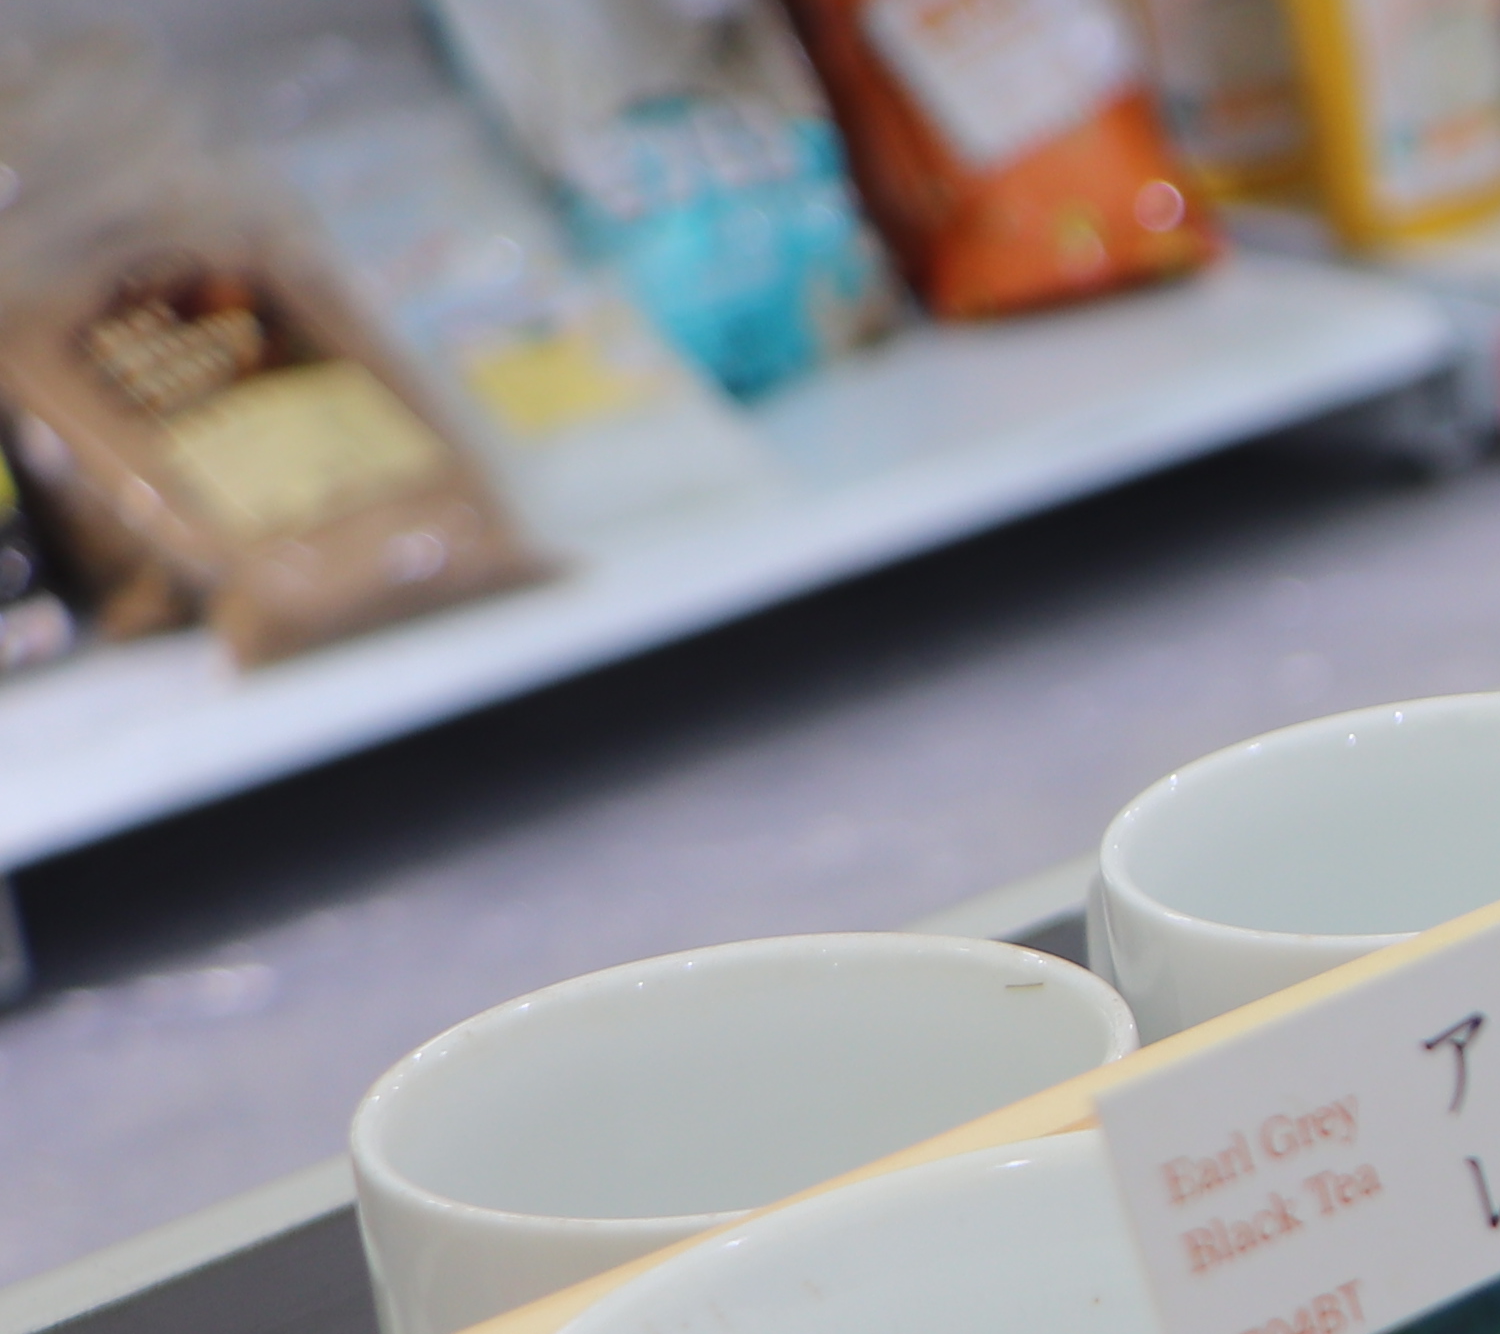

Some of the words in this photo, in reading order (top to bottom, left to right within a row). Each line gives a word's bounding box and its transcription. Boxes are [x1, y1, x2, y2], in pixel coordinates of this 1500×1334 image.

[1160, 1130, 1256, 1207] Earl
[1258, 1092, 1360, 1161] Grey
[1180, 1190, 1304, 1274] Black
[1302, 1162, 1384, 1216] Tea
